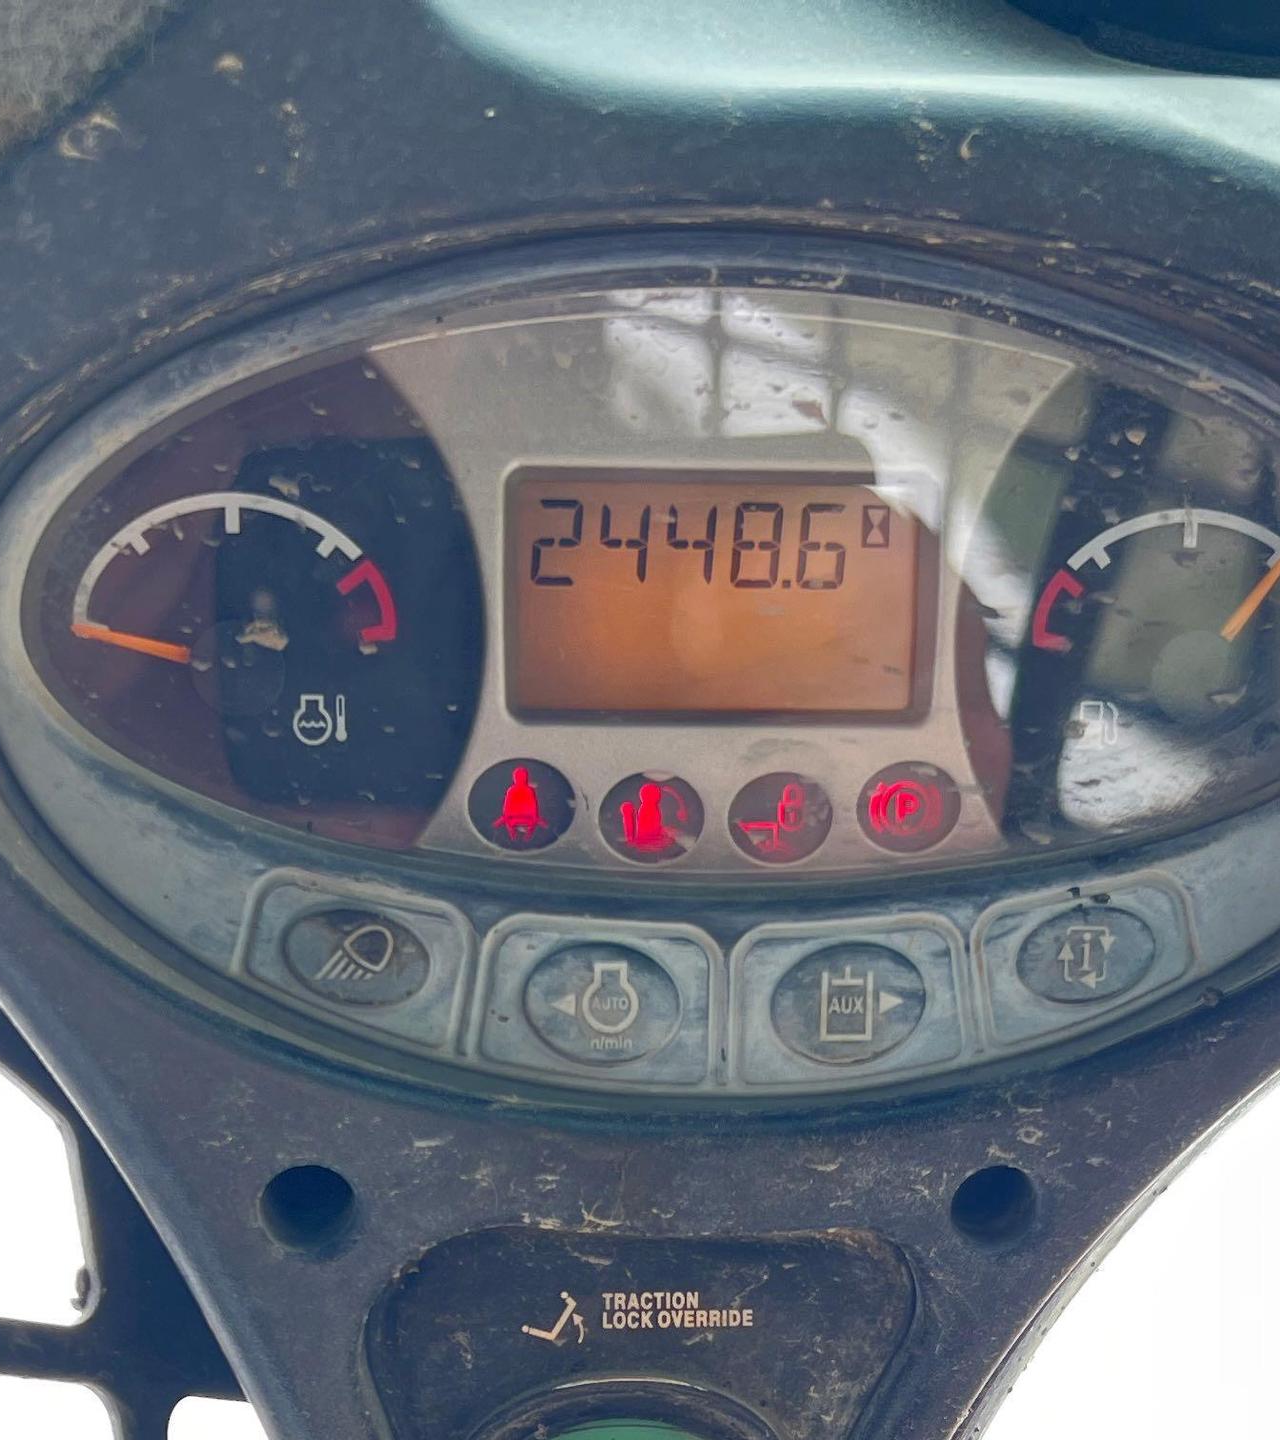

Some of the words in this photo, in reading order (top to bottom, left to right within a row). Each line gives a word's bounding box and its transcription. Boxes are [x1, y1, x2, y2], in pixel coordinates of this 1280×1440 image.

[531, 499, 846, 589] 2448.6
[895, 791, 920, 823] P
[591, 997, 629, 1011] AUTO
[828, 995, 865, 1015] AUX
[590, 1035, 633, 1049] n/min
[602, 1291, 699, 1310] TRACTION
[602, 1310, 654, 1329] LOCK
[657, 1309, 753, 1328] OVERRIDE
